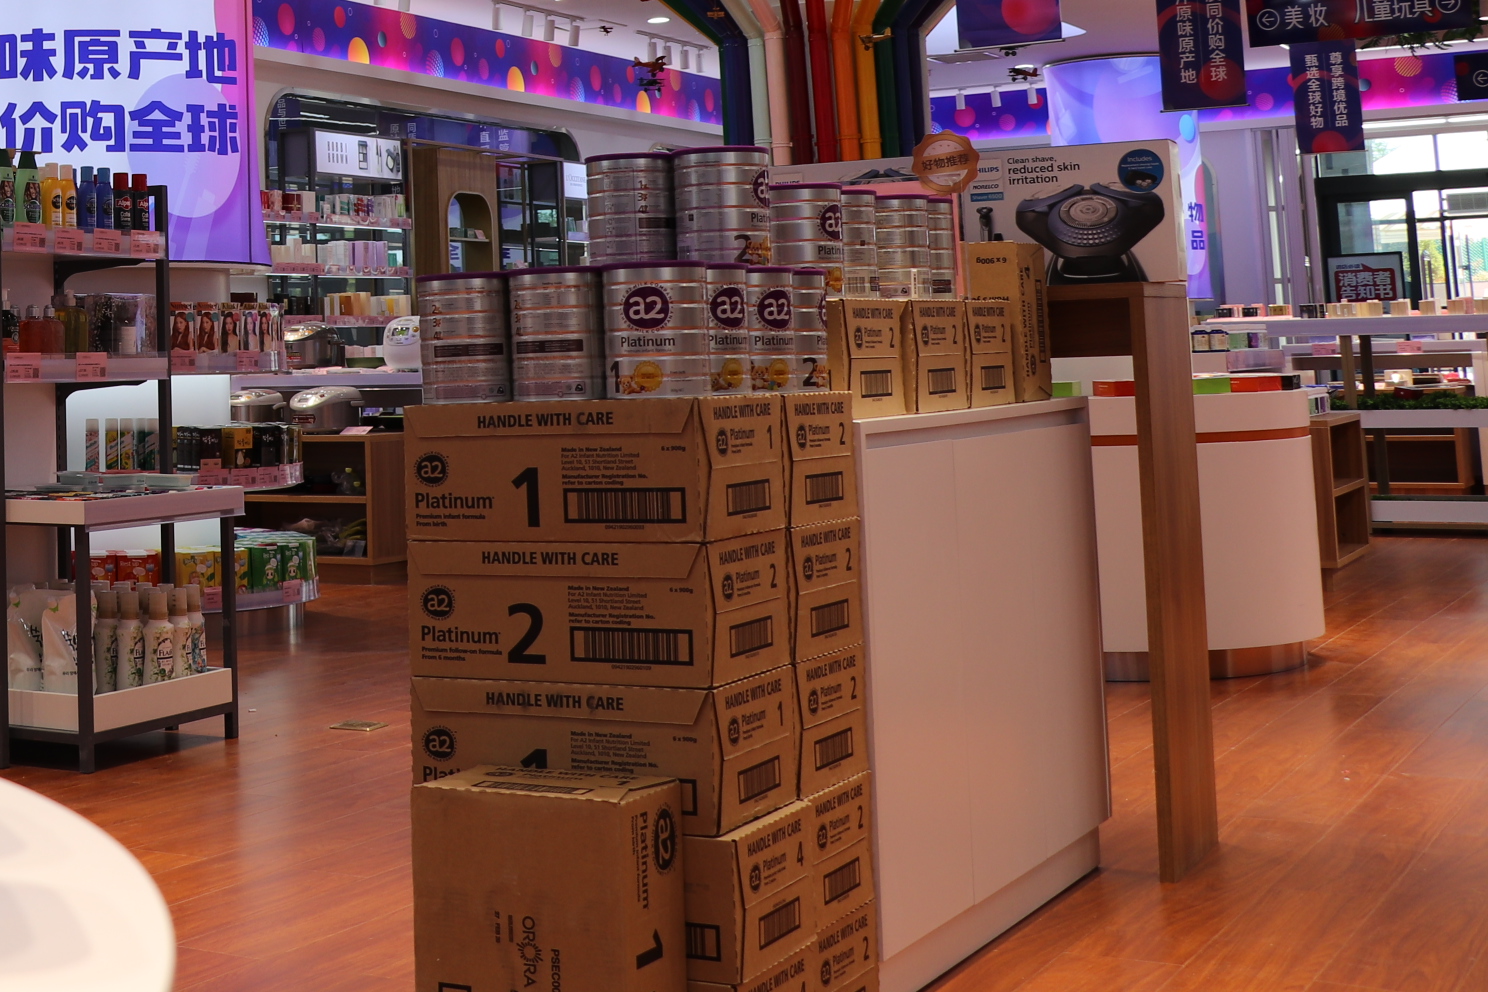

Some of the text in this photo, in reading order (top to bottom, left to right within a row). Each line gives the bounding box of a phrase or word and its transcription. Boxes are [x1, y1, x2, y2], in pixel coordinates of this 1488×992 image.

[1284, 3, 1329, 30] 美妆
[1304, 54, 1325, 129] 甄选全球好物
[1328, 51, 1349, 127] 尊享跨境优品
[921, 154, 970, 171] 好物推荐
[977, 166, 1000, 174] HILIPS
[1007, 157, 1030, 165] Clean
[1008, 162, 1081, 175] reduced skin
[1008, 174, 1058, 186] irritation
[1338, 271, 1391, 287] 消费者
[1340, 285, 1393, 300] 告知书
[629, 296, 665, 320] a2
[716, 296, 744, 319] a2
[763, 298, 790, 320] a2
[620, 336, 676, 348] Platinum
[802, 357, 818, 387] 2
[713, 402, 771, 421] HANDLE WITH CARE
[794, 401, 844, 417] HANDLE WITH CARE
[477, 411, 614, 429] HANDLE WITH CARE
[808, 422, 830, 436] Platinum
[730, 427, 755, 441] Platinum
[766, 424, 773, 450] 1
[839, 422, 846, 446] 2
[420, 460, 444, 478] a2
[415, 492, 493, 510] Platinum
[511, 466, 541, 528] 1
[801, 527, 851, 549] HANDLE WITH CARE
[481, 551, 619, 566] HANDLE WITH CARE
[815, 553, 837, 566] Platinum
[426, 593, 450, 611] a2
[421, 625, 499, 645] Platinum
[507, 602, 547, 665] 2
[478, 648, 502, 656] formula
[486, 691, 624, 711] HANDLE WITH CARE
[428, 734, 452, 752] a2
[747, 818, 802, 858] HANDLE WITH CARE
[639, 811, 650, 910] Platinum
[763, 853, 787, 873] Platinum
[636, 928, 664, 970] 1
